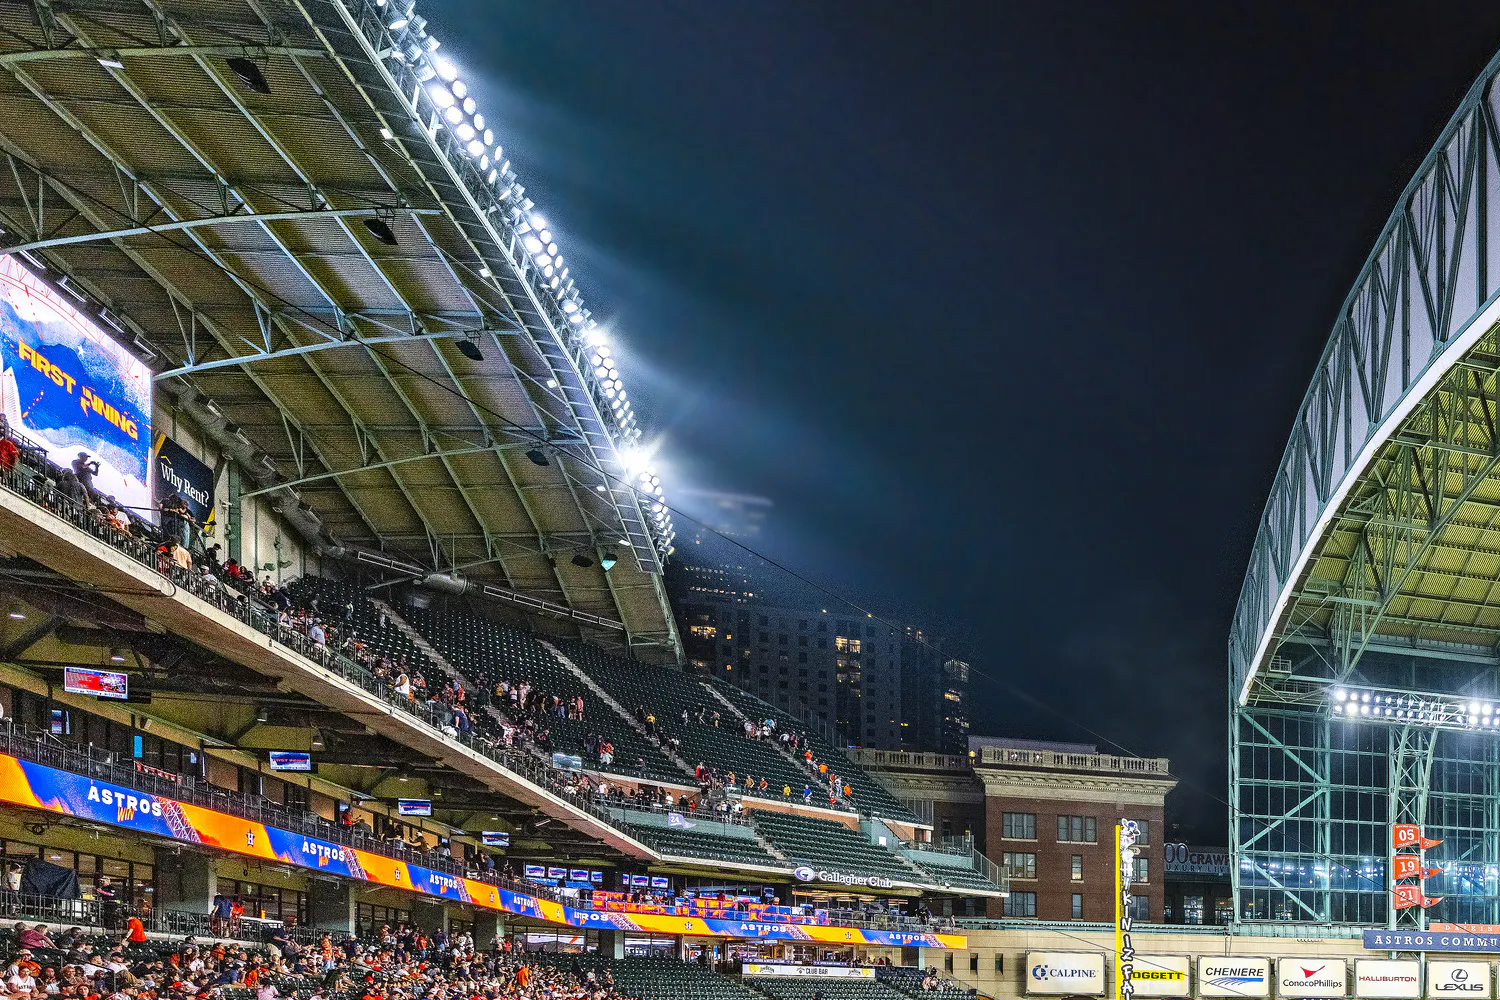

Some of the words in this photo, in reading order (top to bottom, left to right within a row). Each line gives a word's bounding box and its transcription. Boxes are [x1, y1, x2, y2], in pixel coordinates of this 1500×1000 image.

[18, 340, 76, 394] FIRST
[161, 463, 182, 493] Why
[184, 479, 209, 507] Rent?
[87, 786, 162, 817] ASTROS
[1398, 829, 1415, 841] 05
[302, 841, 345, 862] ASTROS
[1400, 860, 1415, 872] 19
[430, 875, 458, 889] ASTROS
[819, 871, 868, 886] Gallagher
[869, 876, 893, 888] Club
[513, 896, 533, 908] ASTROS
[1400, 890, 1413, 902] 21
[741, 923, 787, 933] ASTROS
[889, 933, 926, 941] ASTROS
[1375, 935, 1433, 945] ASTROS
[1050, 969, 1096, 978] CALPINE
[1131, 972, 1183, 980] OGGETT
[1205, 967, 1264, 977] CHENIERE
[1282, 979, 1342, 988] ConocoPhillips
[1435, 984, 1484, 992] LEXUS
